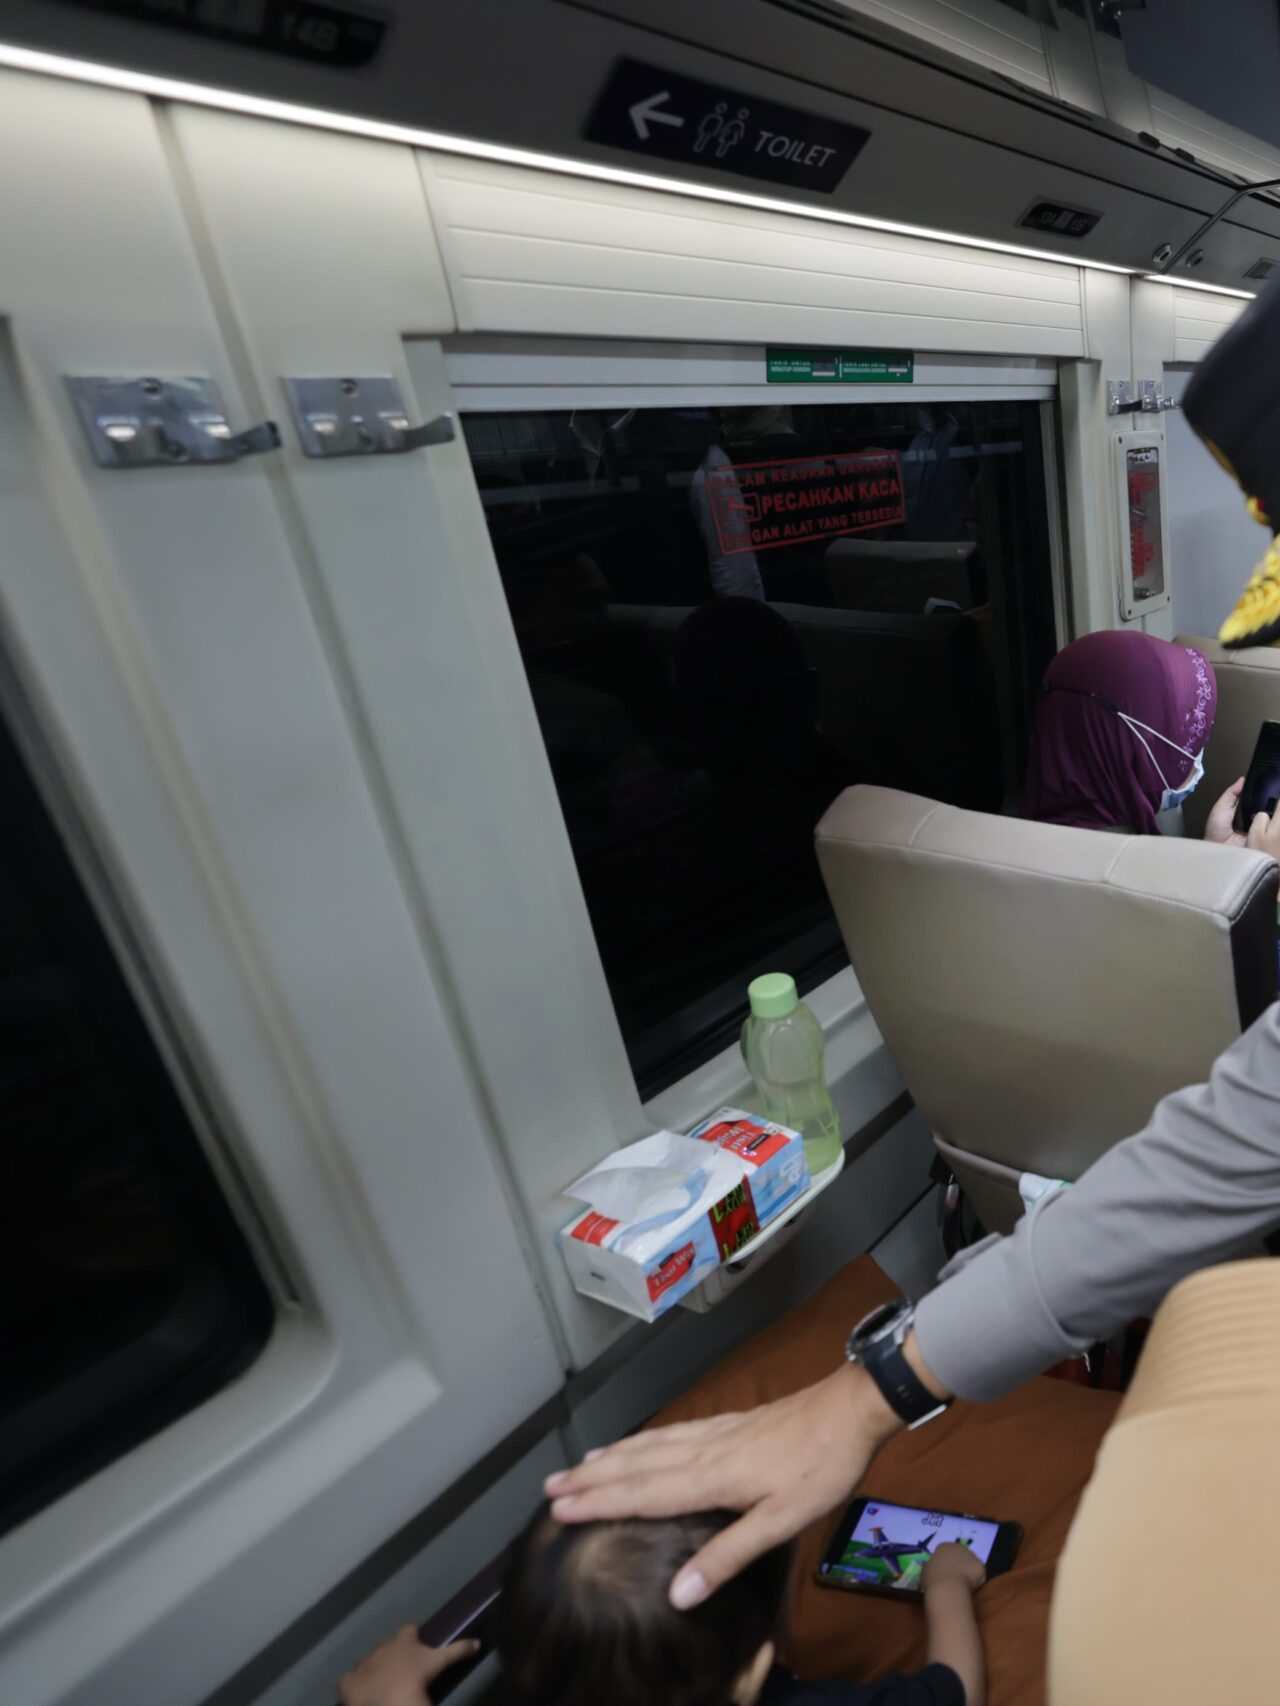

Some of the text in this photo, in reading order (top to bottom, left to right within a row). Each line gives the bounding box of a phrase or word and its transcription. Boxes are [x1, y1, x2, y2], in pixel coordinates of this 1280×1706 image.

[754, 130, 838, 168] TOILET
[763, 479, 900, 514] PECAHKAN KACA
[783, 519, 813, 537] ALAT
